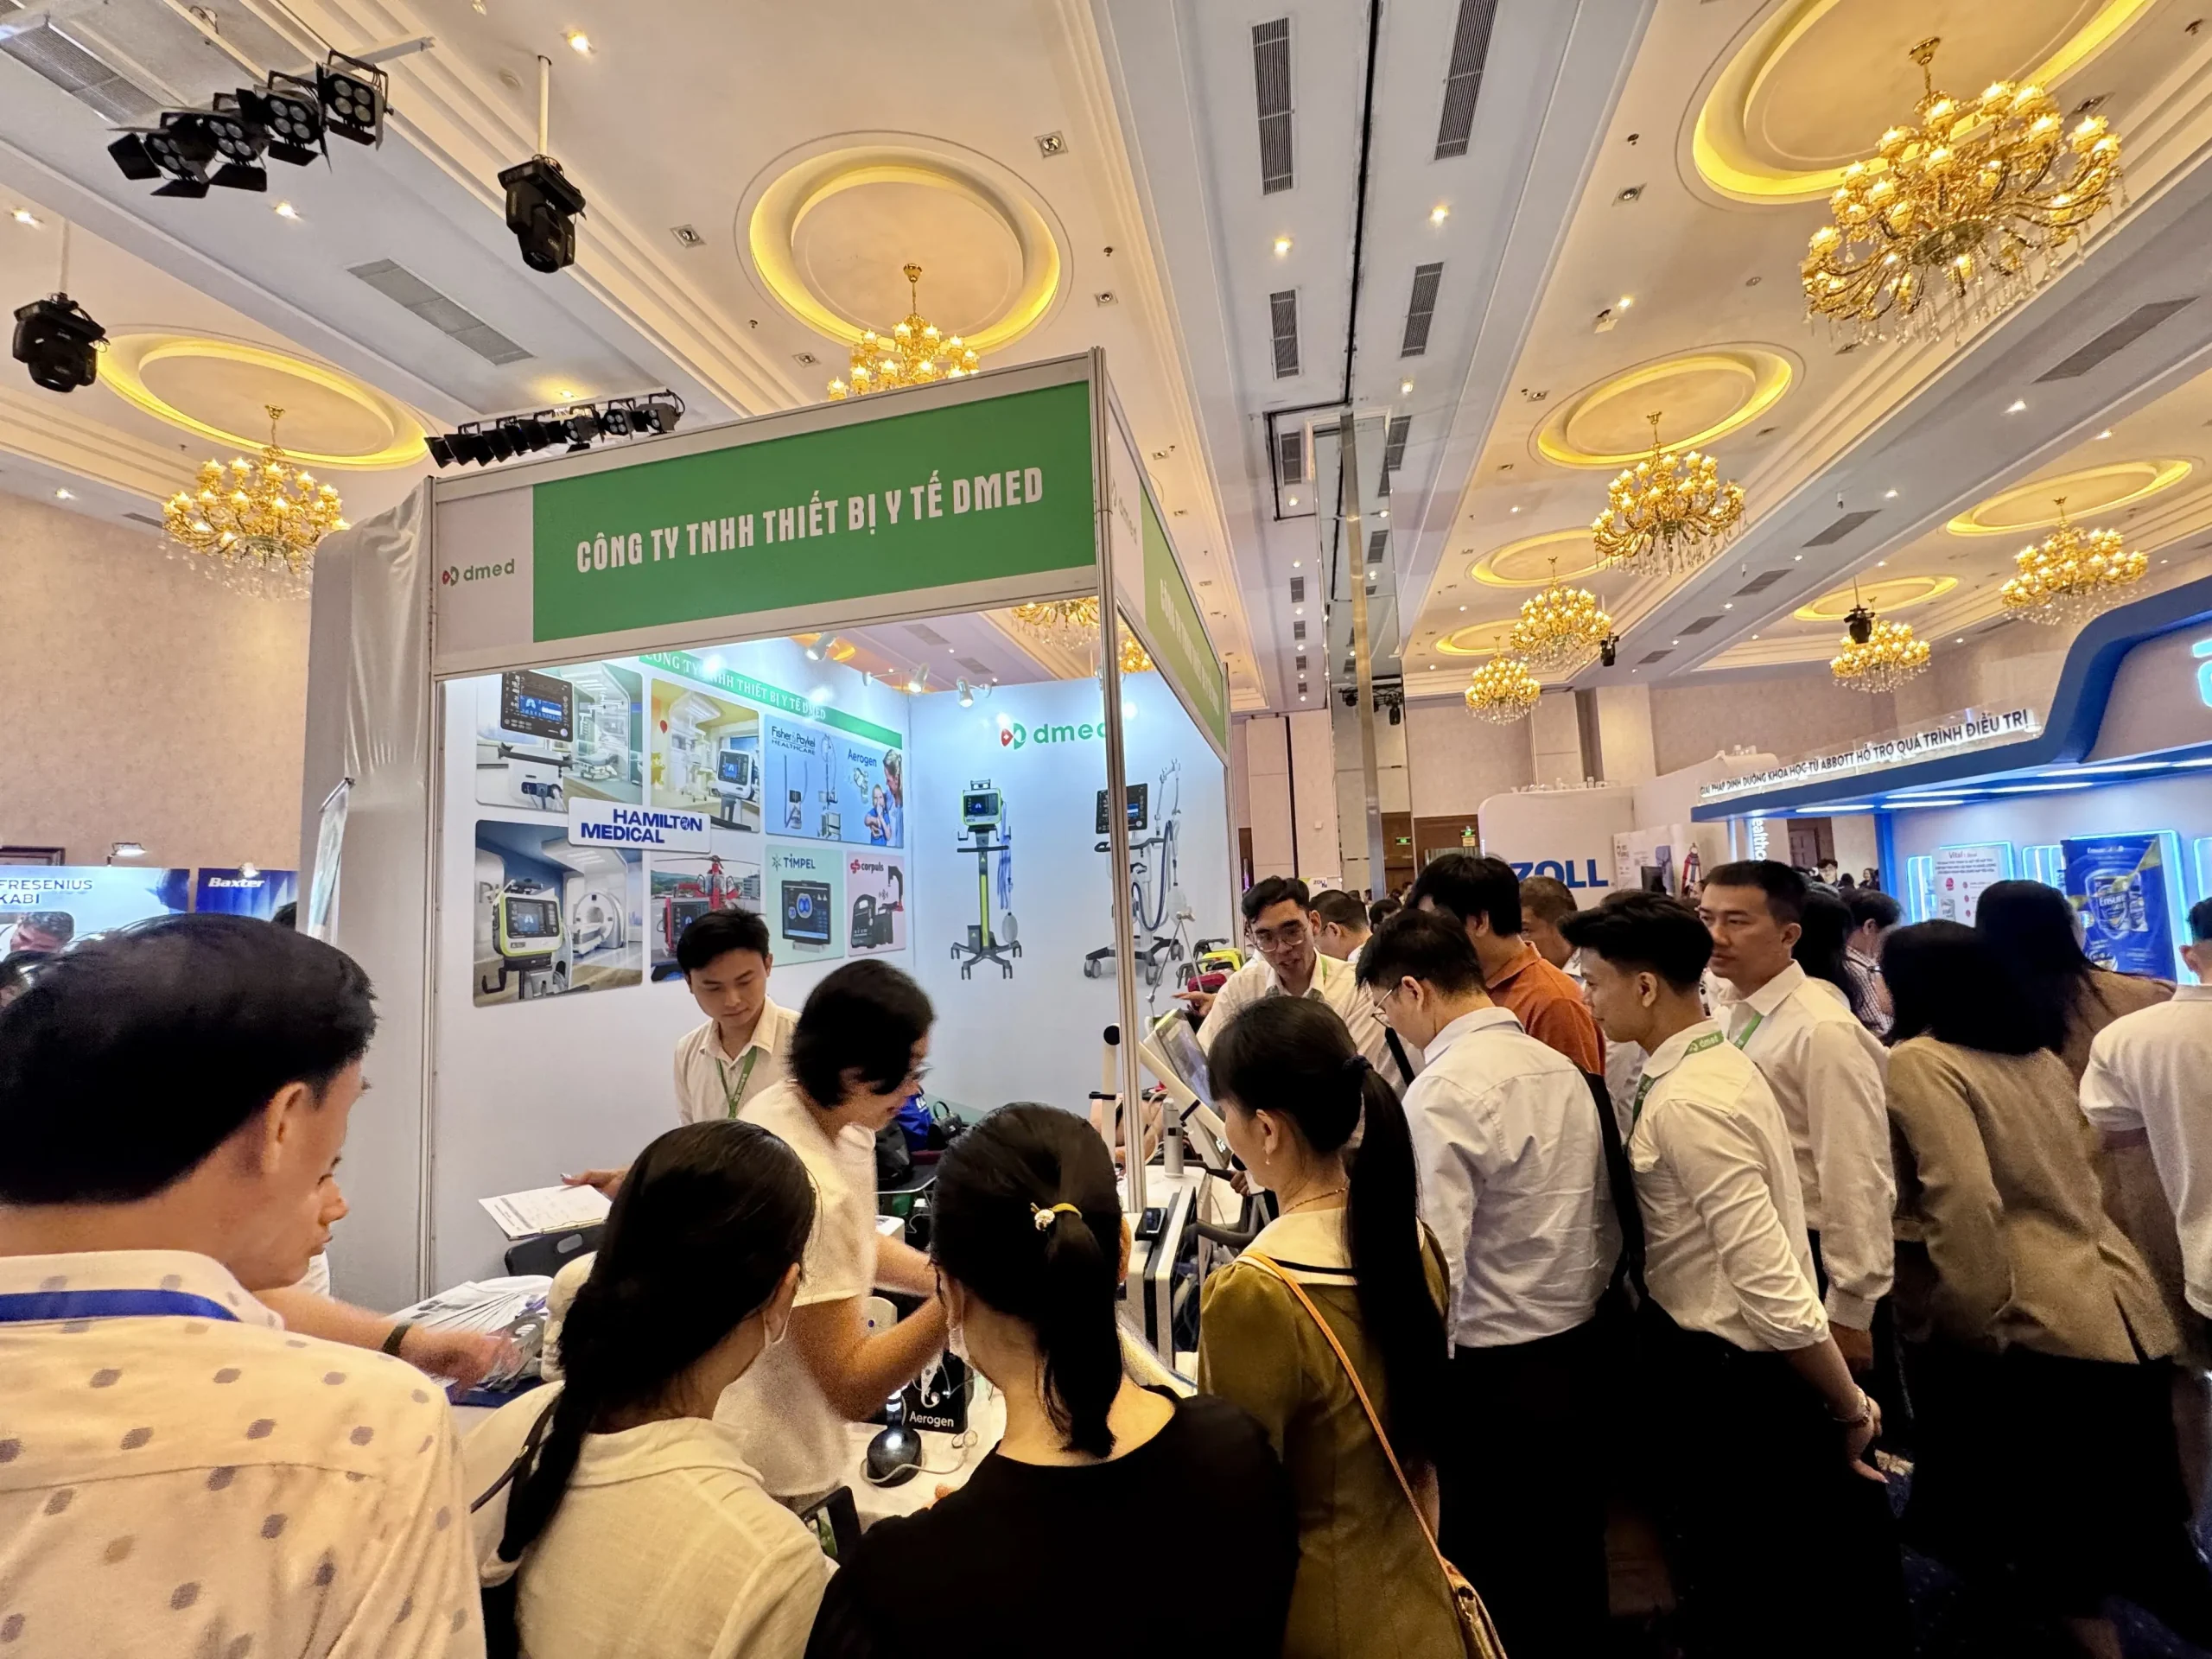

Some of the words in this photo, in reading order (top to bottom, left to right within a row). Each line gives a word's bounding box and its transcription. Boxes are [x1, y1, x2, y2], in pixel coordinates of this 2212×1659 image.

[577, 531, 643, 573] CÔNG
[651, 526, 679, 562] TY
[686, 514, 754, 556] TNHH
[763, 490, 839, 543] THIẾT
[848, 493, 876, 535] BỊ
[885, 489, 902, 524] Y
[910, 469, 944, 520] TẾ
[952, 467, 1043, 514] DMED
[463, 558, 515, 582] dmed
[772, 739, 816, 756] HEALTHCARE
[848, 747, 877, 767] Aerogen
[1768, 768, 1789, 781] KHOA
[1821, 751, 1854, 769] ABBOTT
[1923, 725, 1962, 748] TRÌNH
[613, 809, 702, 832] HAMILTON
[581, 823, 665, 843] MEDICAL
[861, 861, 884, 874] corpuls
[208, 877, 265, 888] Baxter
[909, 1410, 955, 1427] Aerogen
